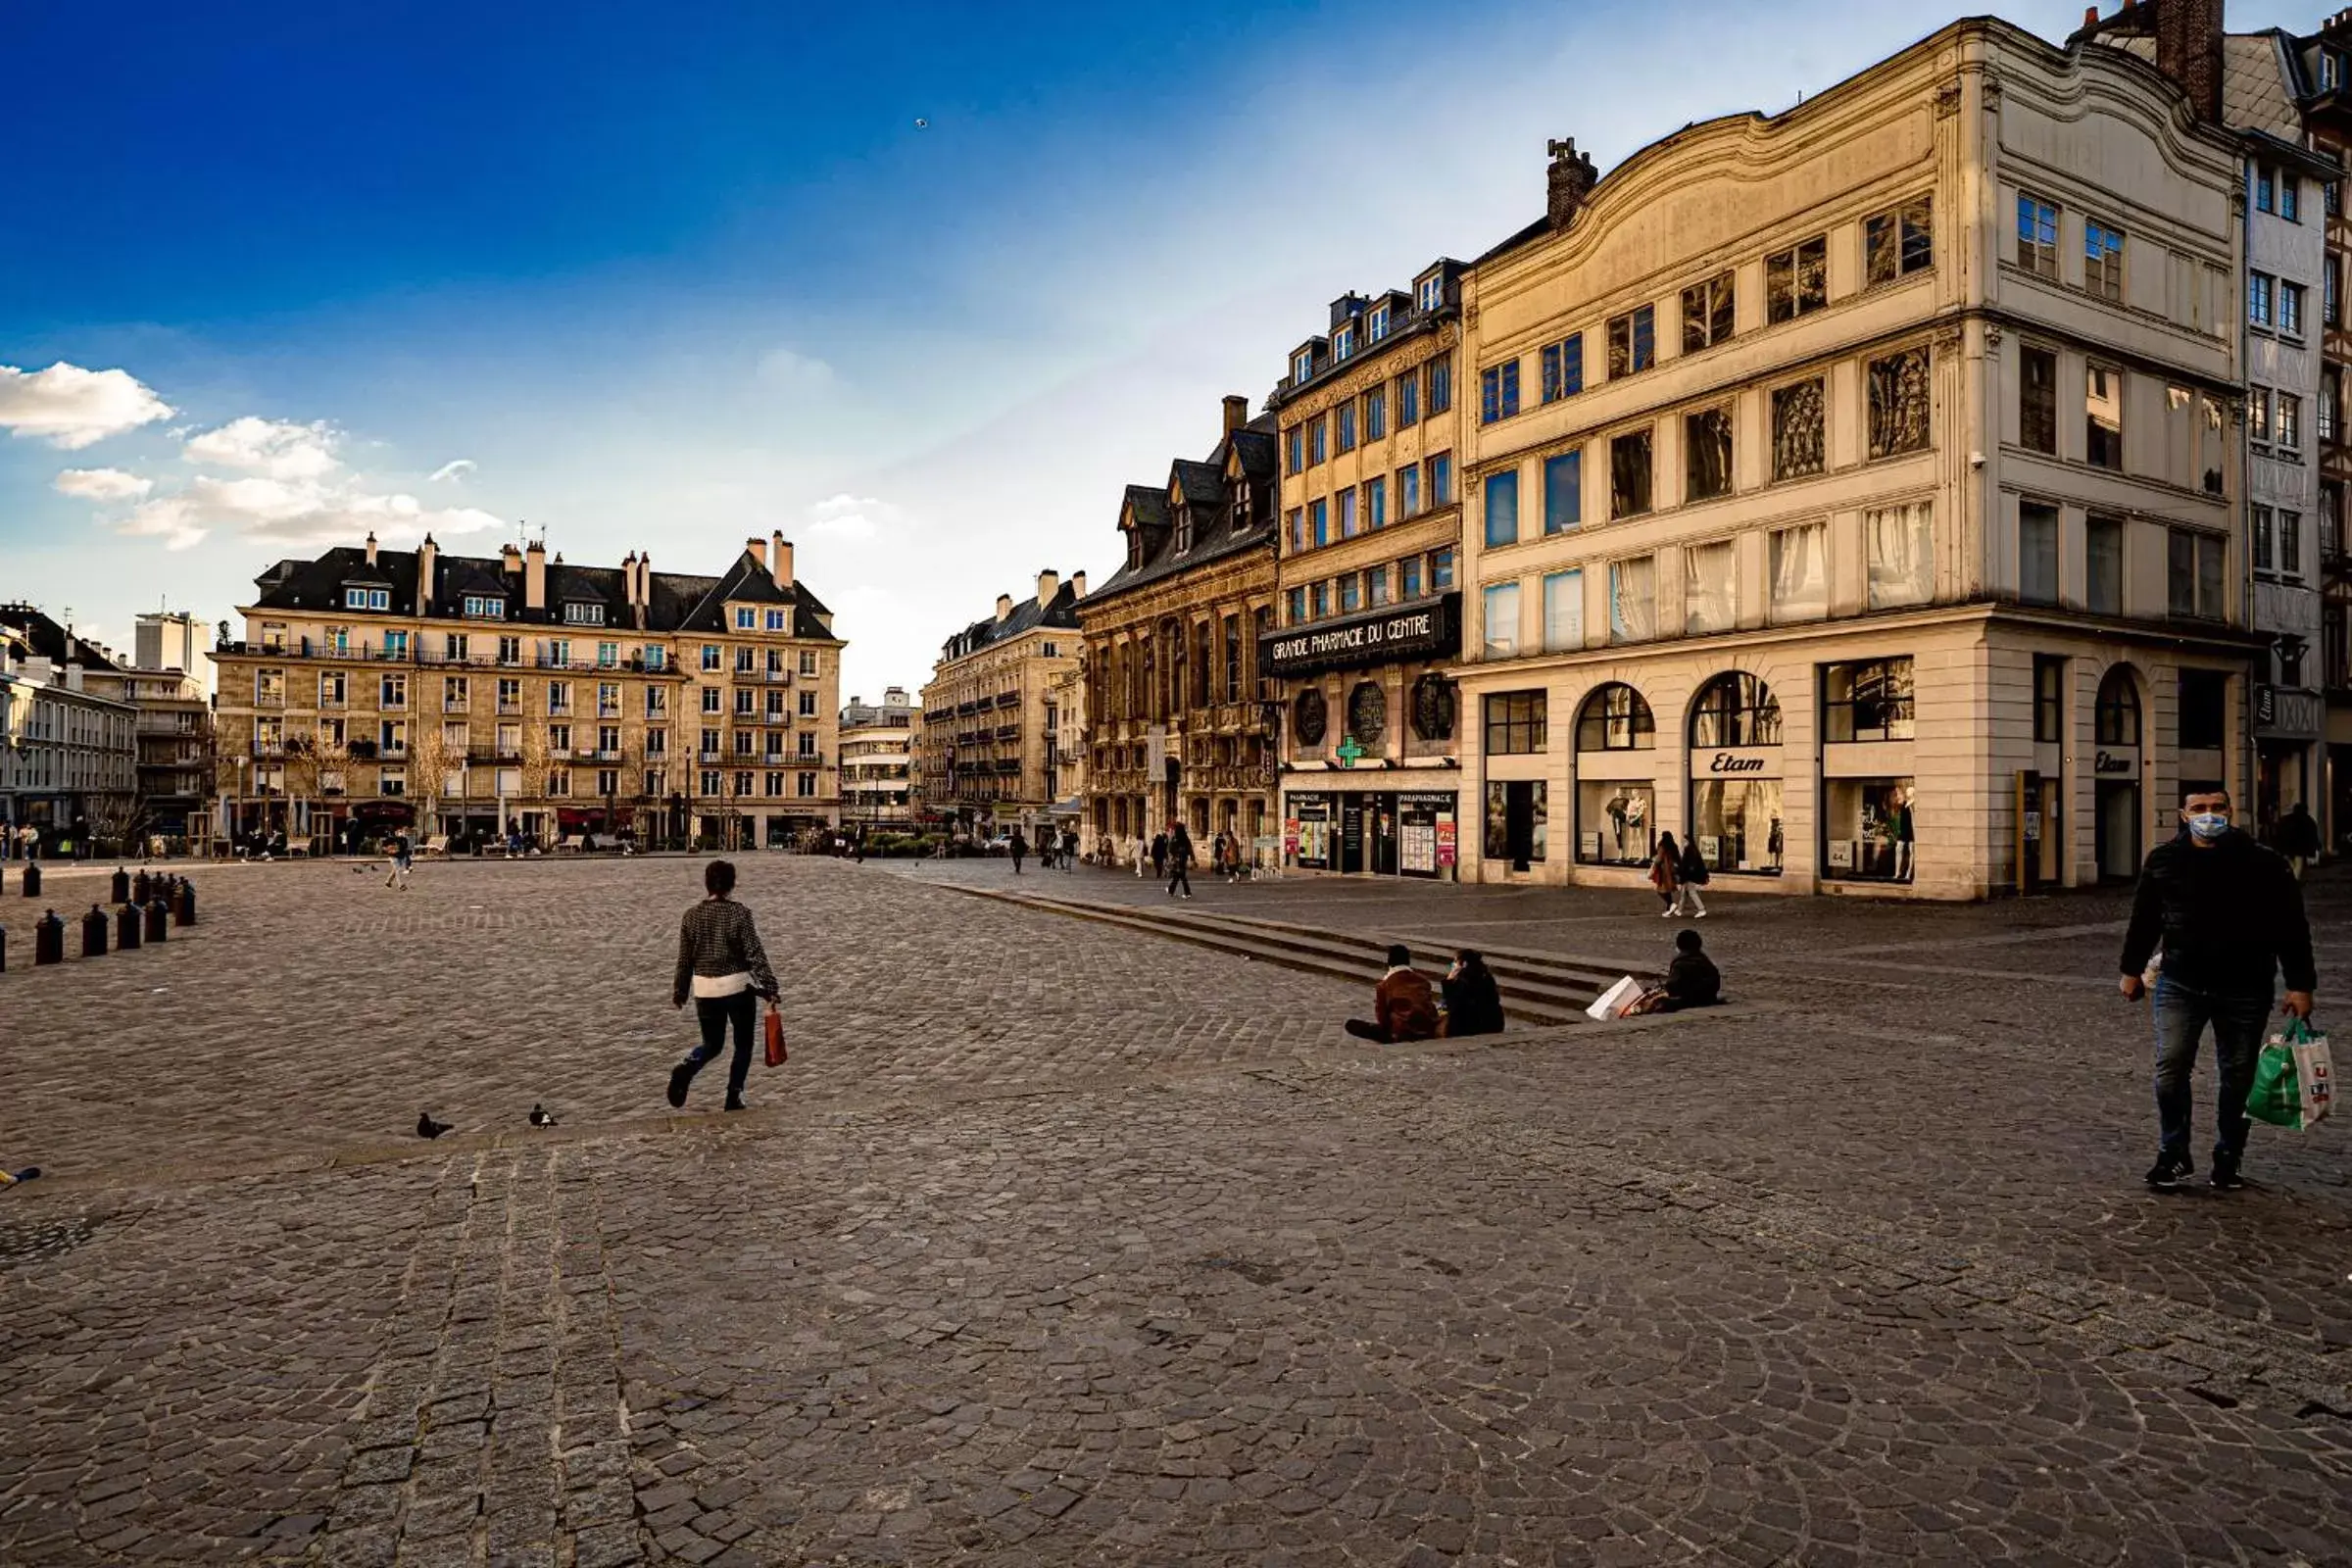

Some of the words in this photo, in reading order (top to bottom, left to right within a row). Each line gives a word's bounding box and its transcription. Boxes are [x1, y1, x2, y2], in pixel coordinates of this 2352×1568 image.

[1273, 637, 1307, 660] GRANDE
[1311, 626, 1364, 654] PHARMACIE
[1368, 623, 1383, 644] DU
[1387, 613, 1430, 640] CENTRE
[1710, 752, 1764, 772] Etam
